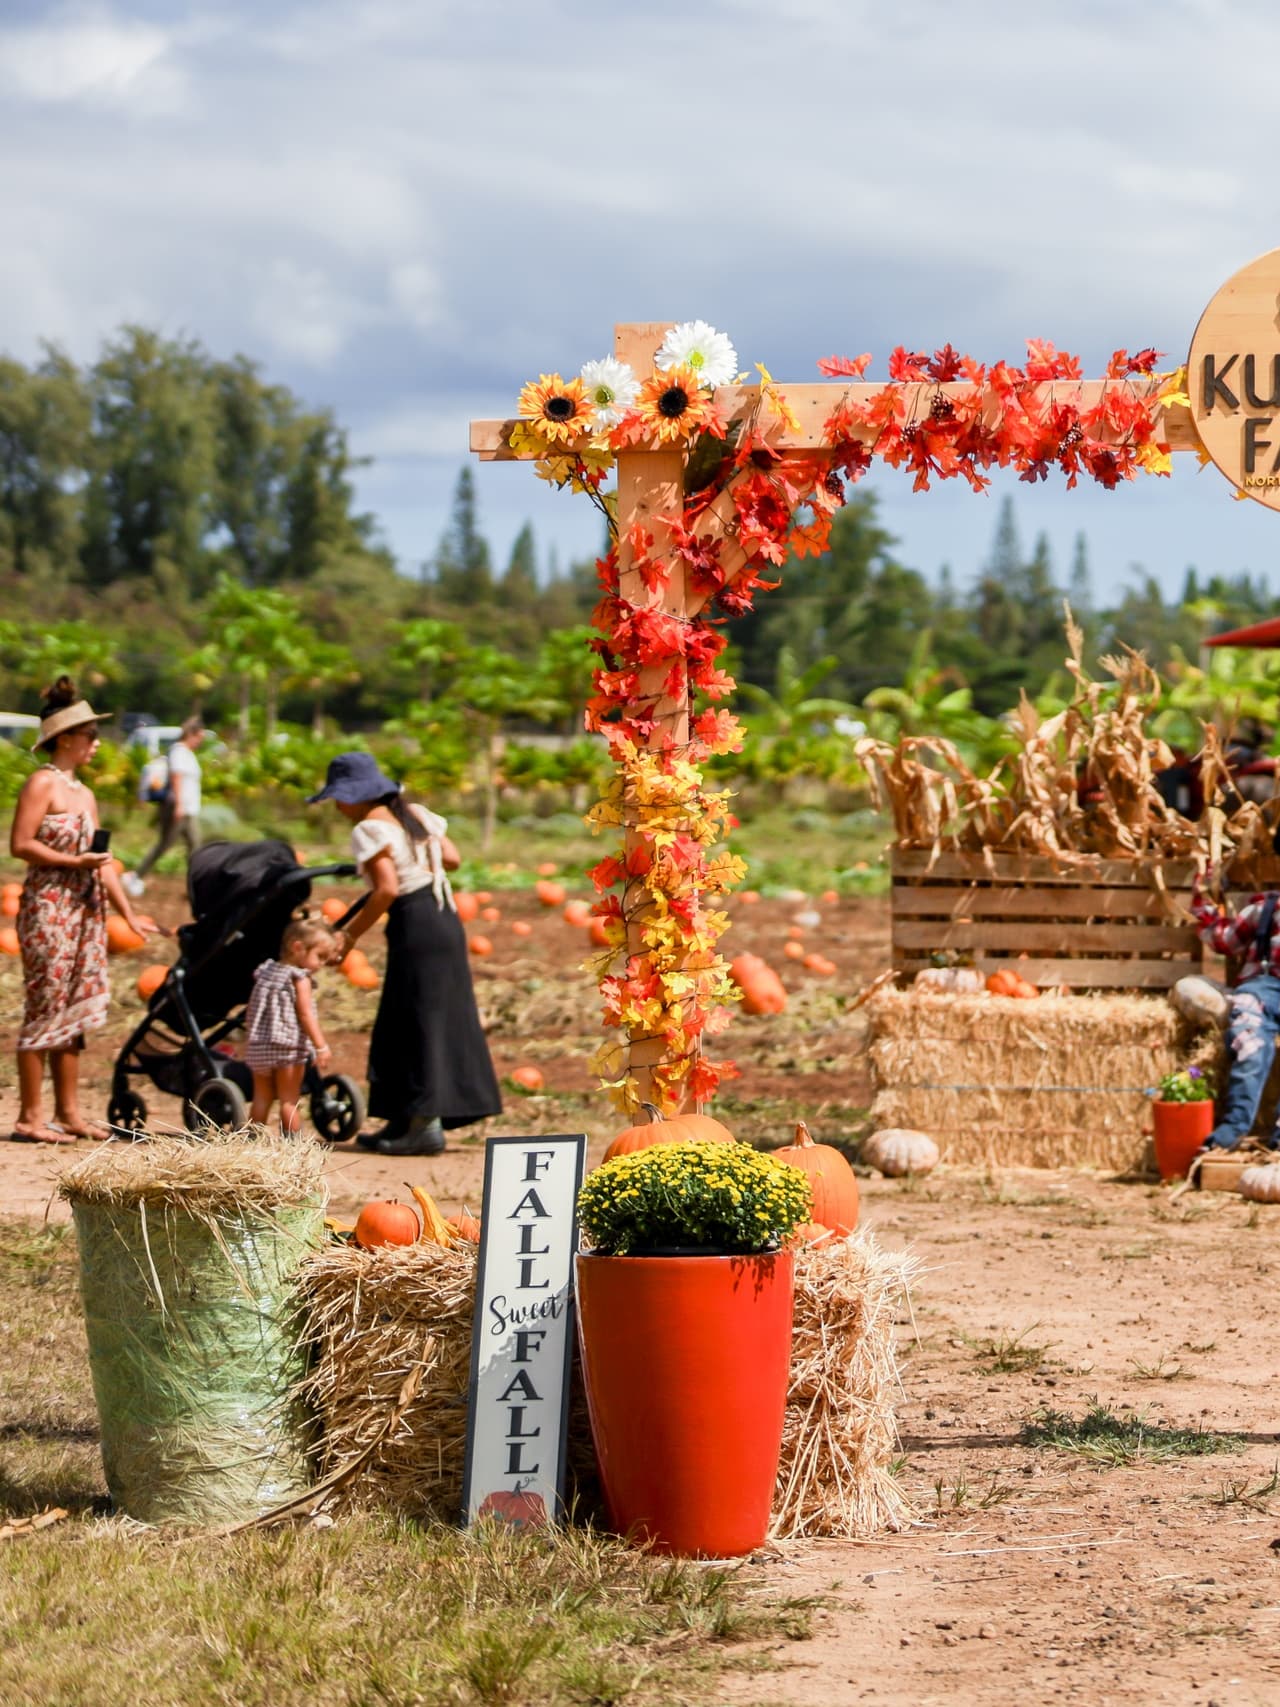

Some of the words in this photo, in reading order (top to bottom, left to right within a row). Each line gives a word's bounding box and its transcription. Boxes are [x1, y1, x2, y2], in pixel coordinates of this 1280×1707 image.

[506, 1150, 555, 1289] FALL
[489, 1293, 566, 1336] Sweet
[496, 1330, 547, 1475] FALL
